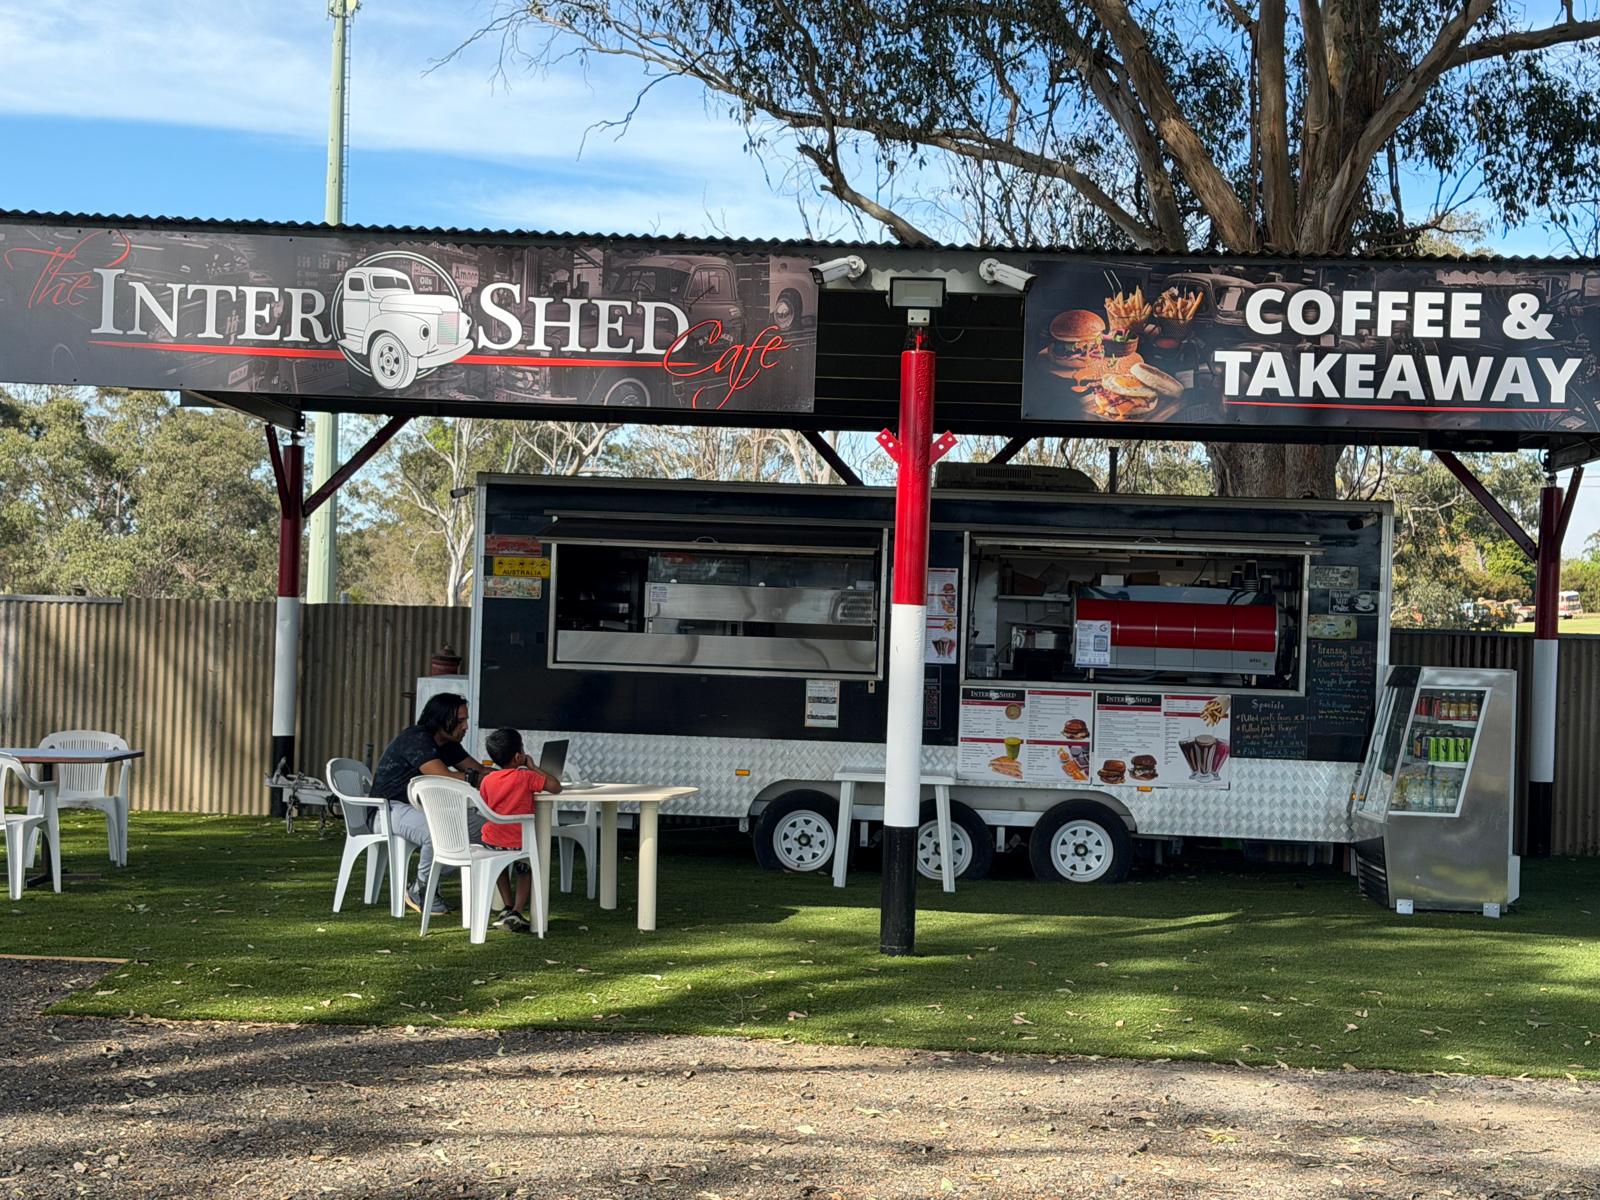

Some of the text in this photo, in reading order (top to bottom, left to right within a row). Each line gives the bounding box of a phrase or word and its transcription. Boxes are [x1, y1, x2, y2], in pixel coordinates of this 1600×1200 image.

[4, 229, 131, 308] The
[91, 268, 332, 343] INTER
[478, 283, 690, 355] SHED
[1245, 288, 1554, 341] COFFEE &
[1214, 351, 1582, 403] TAKEAWAY
[999, 691, 1017, 699] SHED
[1106, 695, 1125, 703] INTER
